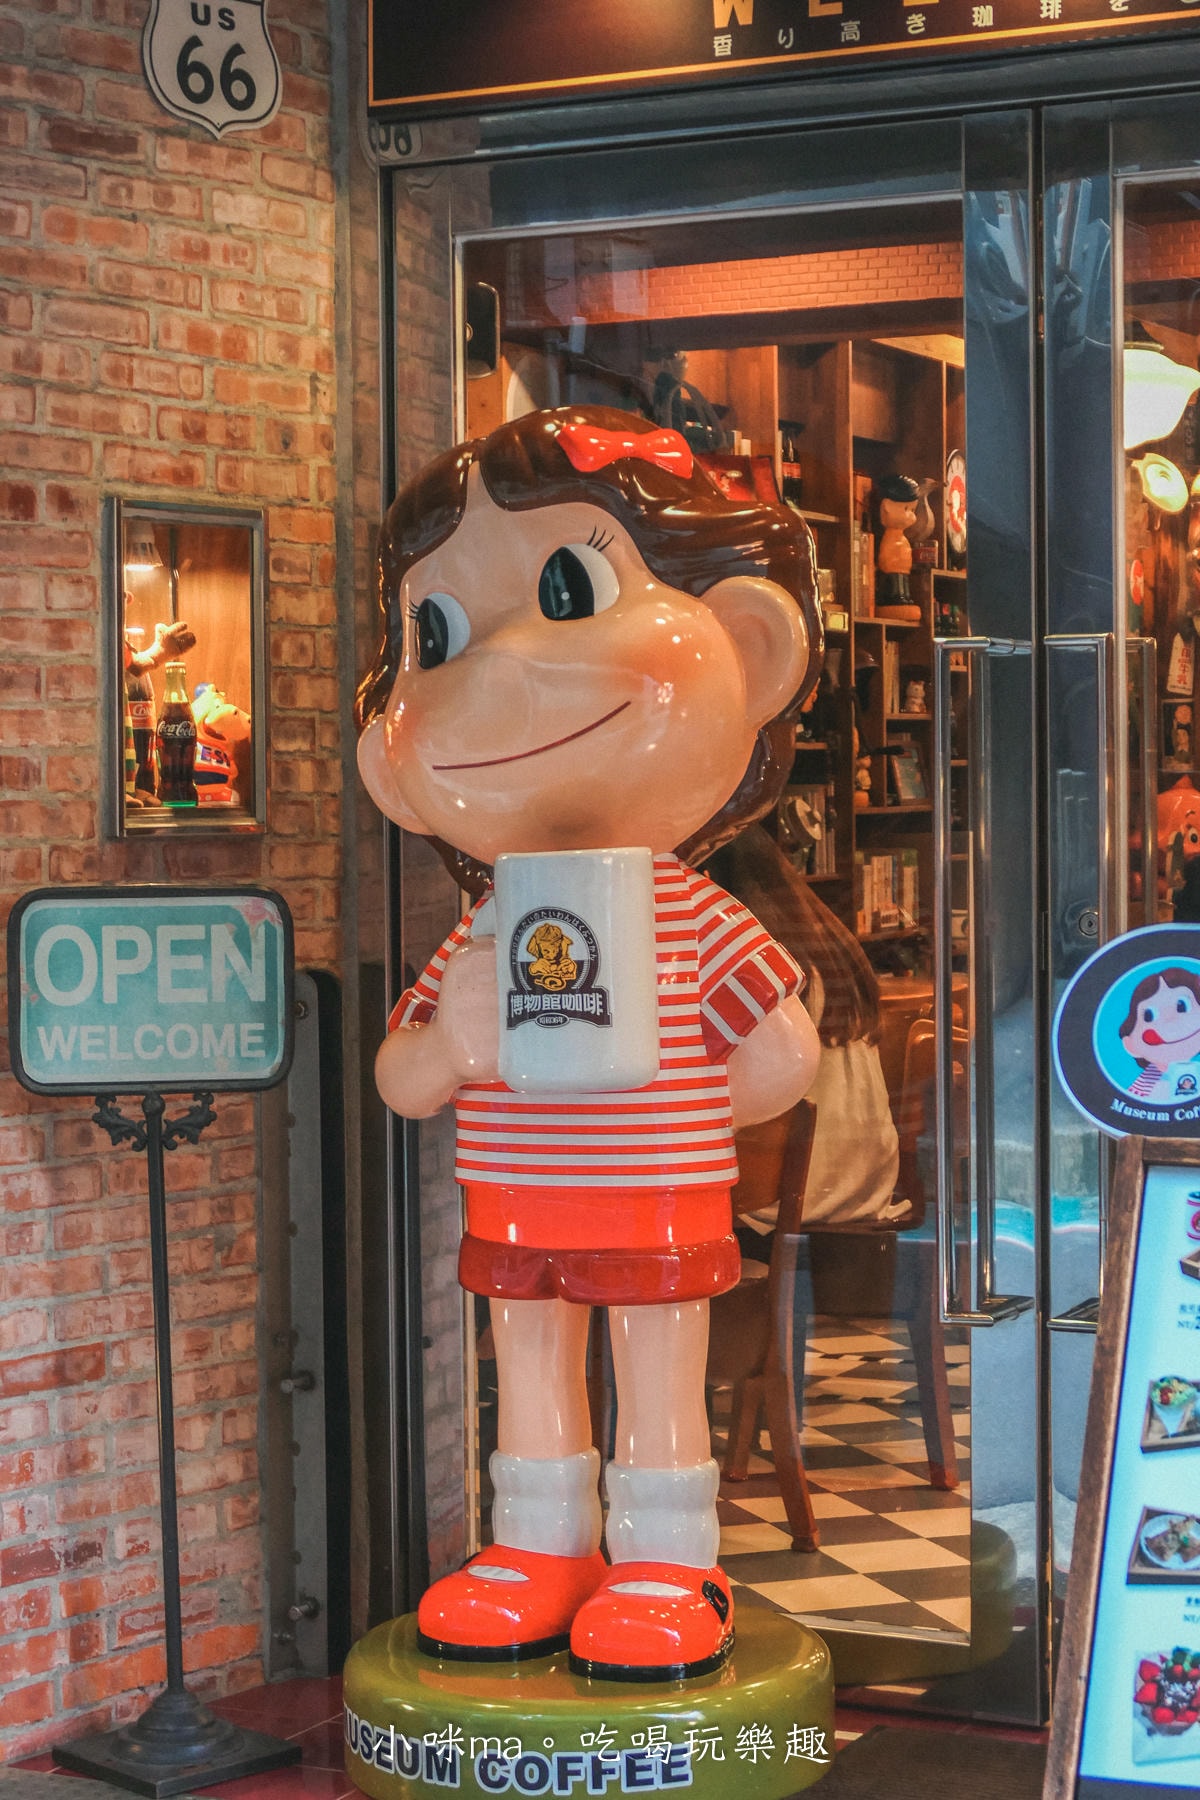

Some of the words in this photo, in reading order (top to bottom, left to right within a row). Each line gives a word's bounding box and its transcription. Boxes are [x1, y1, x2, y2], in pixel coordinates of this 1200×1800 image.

[190, 2, 236, 31] US
[713, 0, 1198, 57] 香り高き珈琲を
[177, 35, 256, 112] 66
[34, 924, 266, 1007] OPEN
[37, 1022, 266, 1062] WELCOME
[1109, 1097, 1170, 1121] Museum
[1174, 1105, 1200, 1121] Cof
[344, 1705, 461, 1788] USEUM
[475, 1745, 692, 1795] COFFEE
